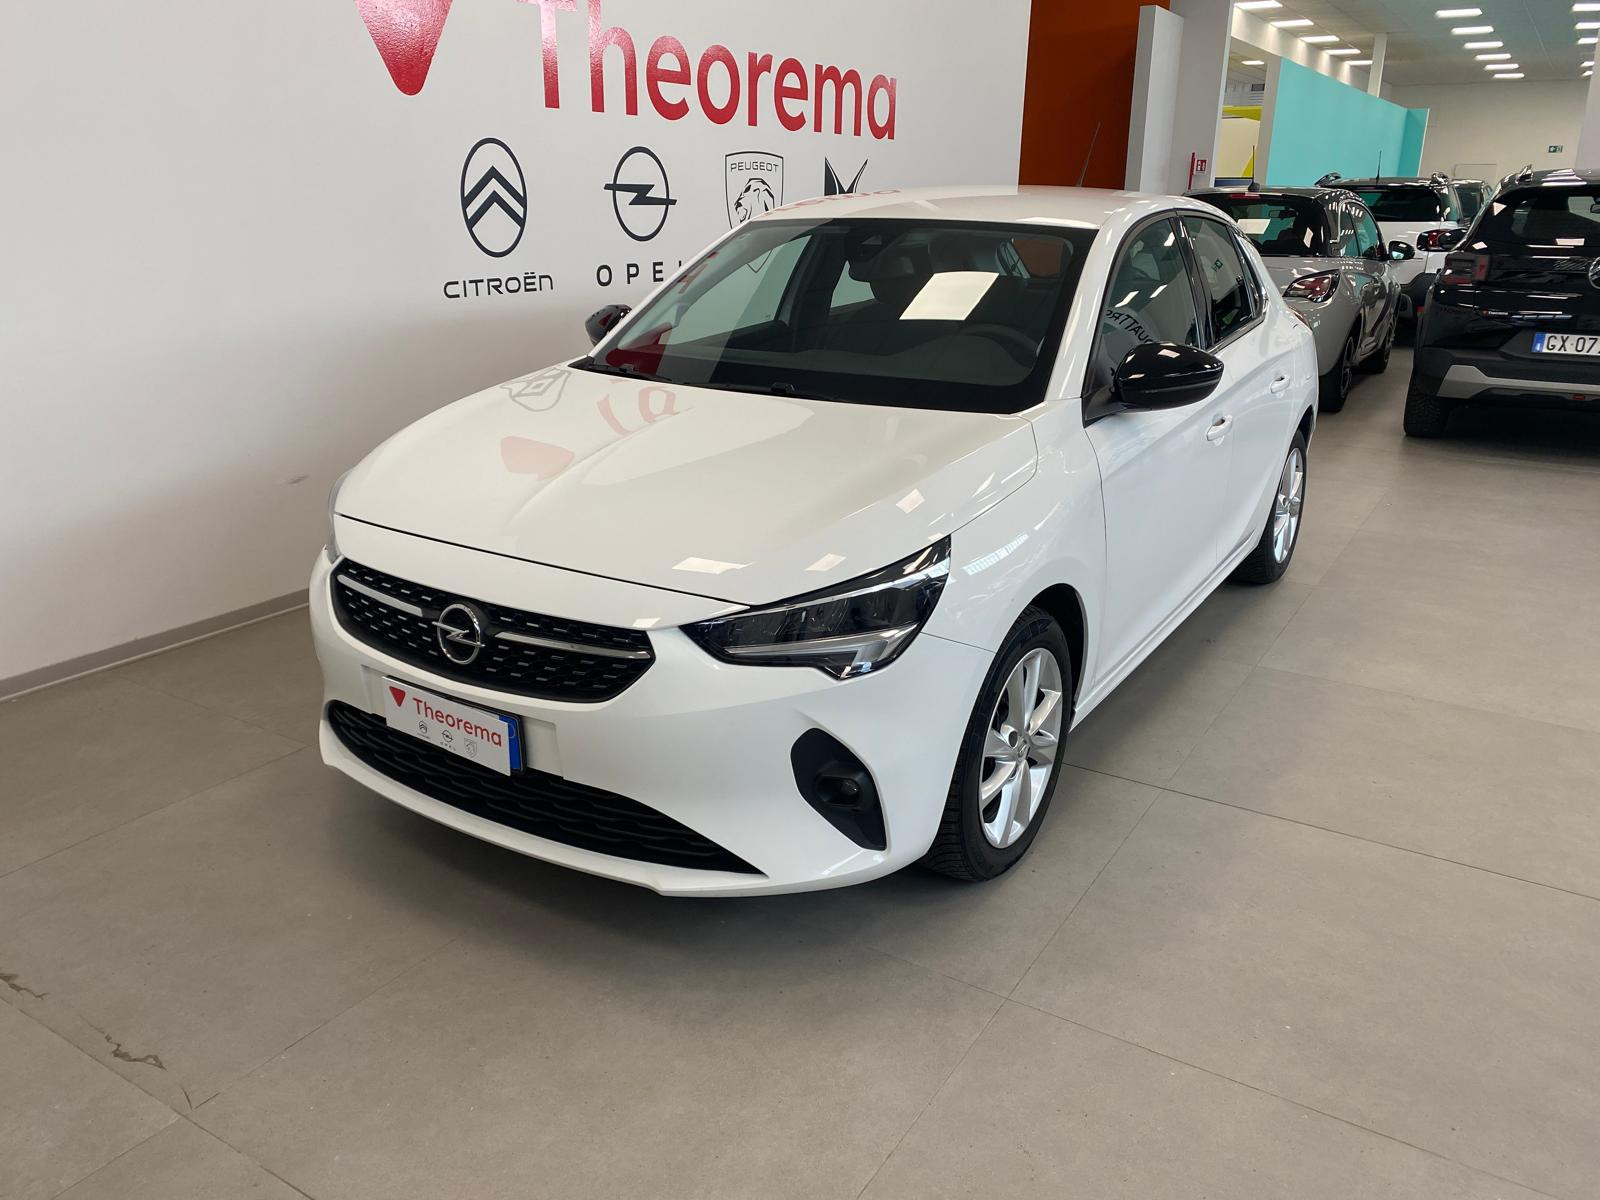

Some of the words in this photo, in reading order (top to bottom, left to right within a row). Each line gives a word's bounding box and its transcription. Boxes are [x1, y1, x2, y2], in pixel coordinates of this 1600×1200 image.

[516, 0, 898, 140] Theorema
[730, 161, 779, 173] PEUGEOT
[1575, 337, 1600, 354] 07
[412, 697, 503, 747] Theorema
